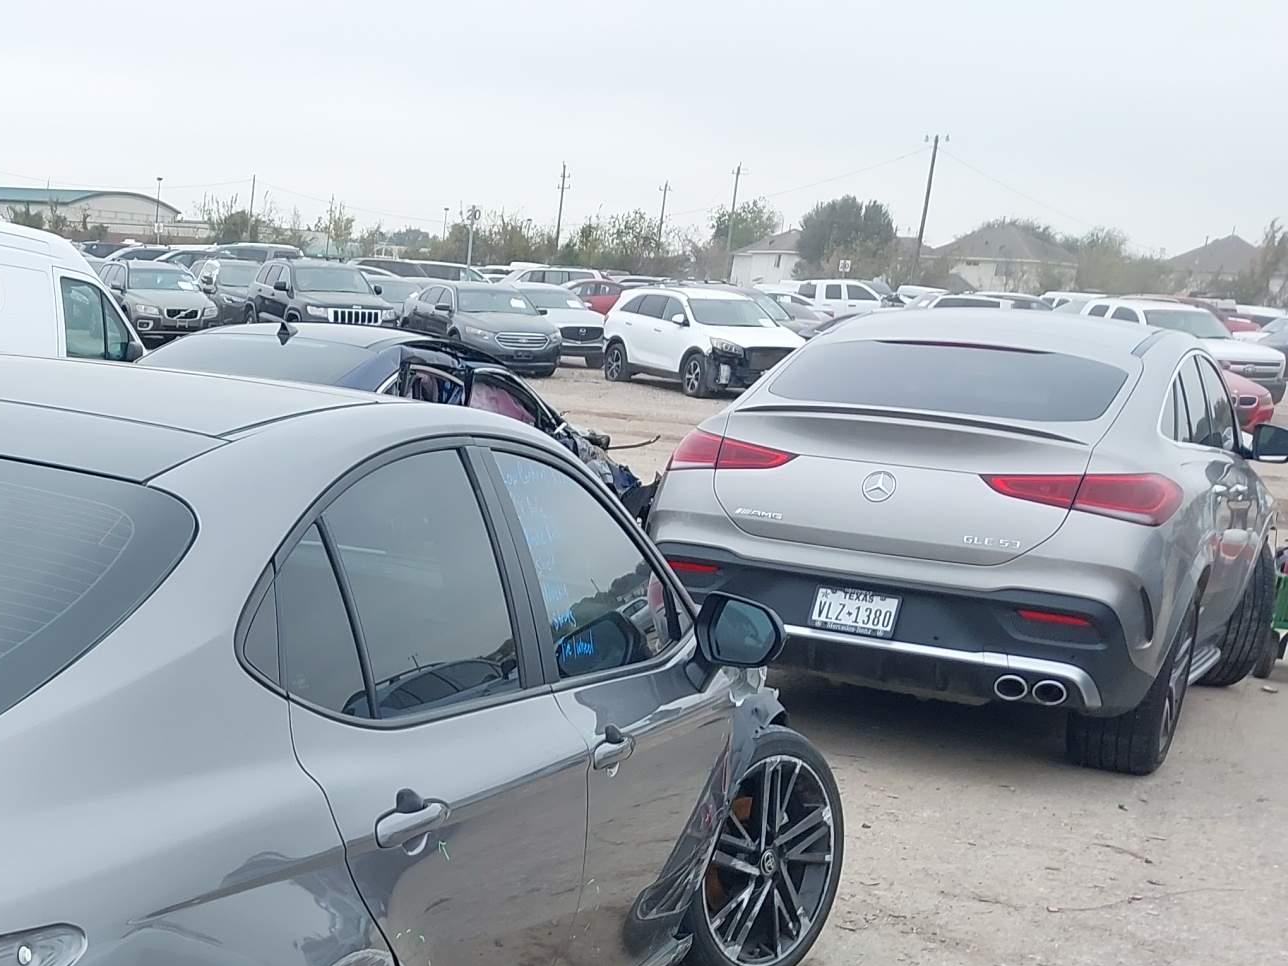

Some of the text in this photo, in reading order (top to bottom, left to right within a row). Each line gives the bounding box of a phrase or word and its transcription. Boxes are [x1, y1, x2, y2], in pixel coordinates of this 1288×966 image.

[466, 208, 481, 221] 20
[963, 535, 993, 546] GLE
[843, 591, 874, 604] TEXAS
